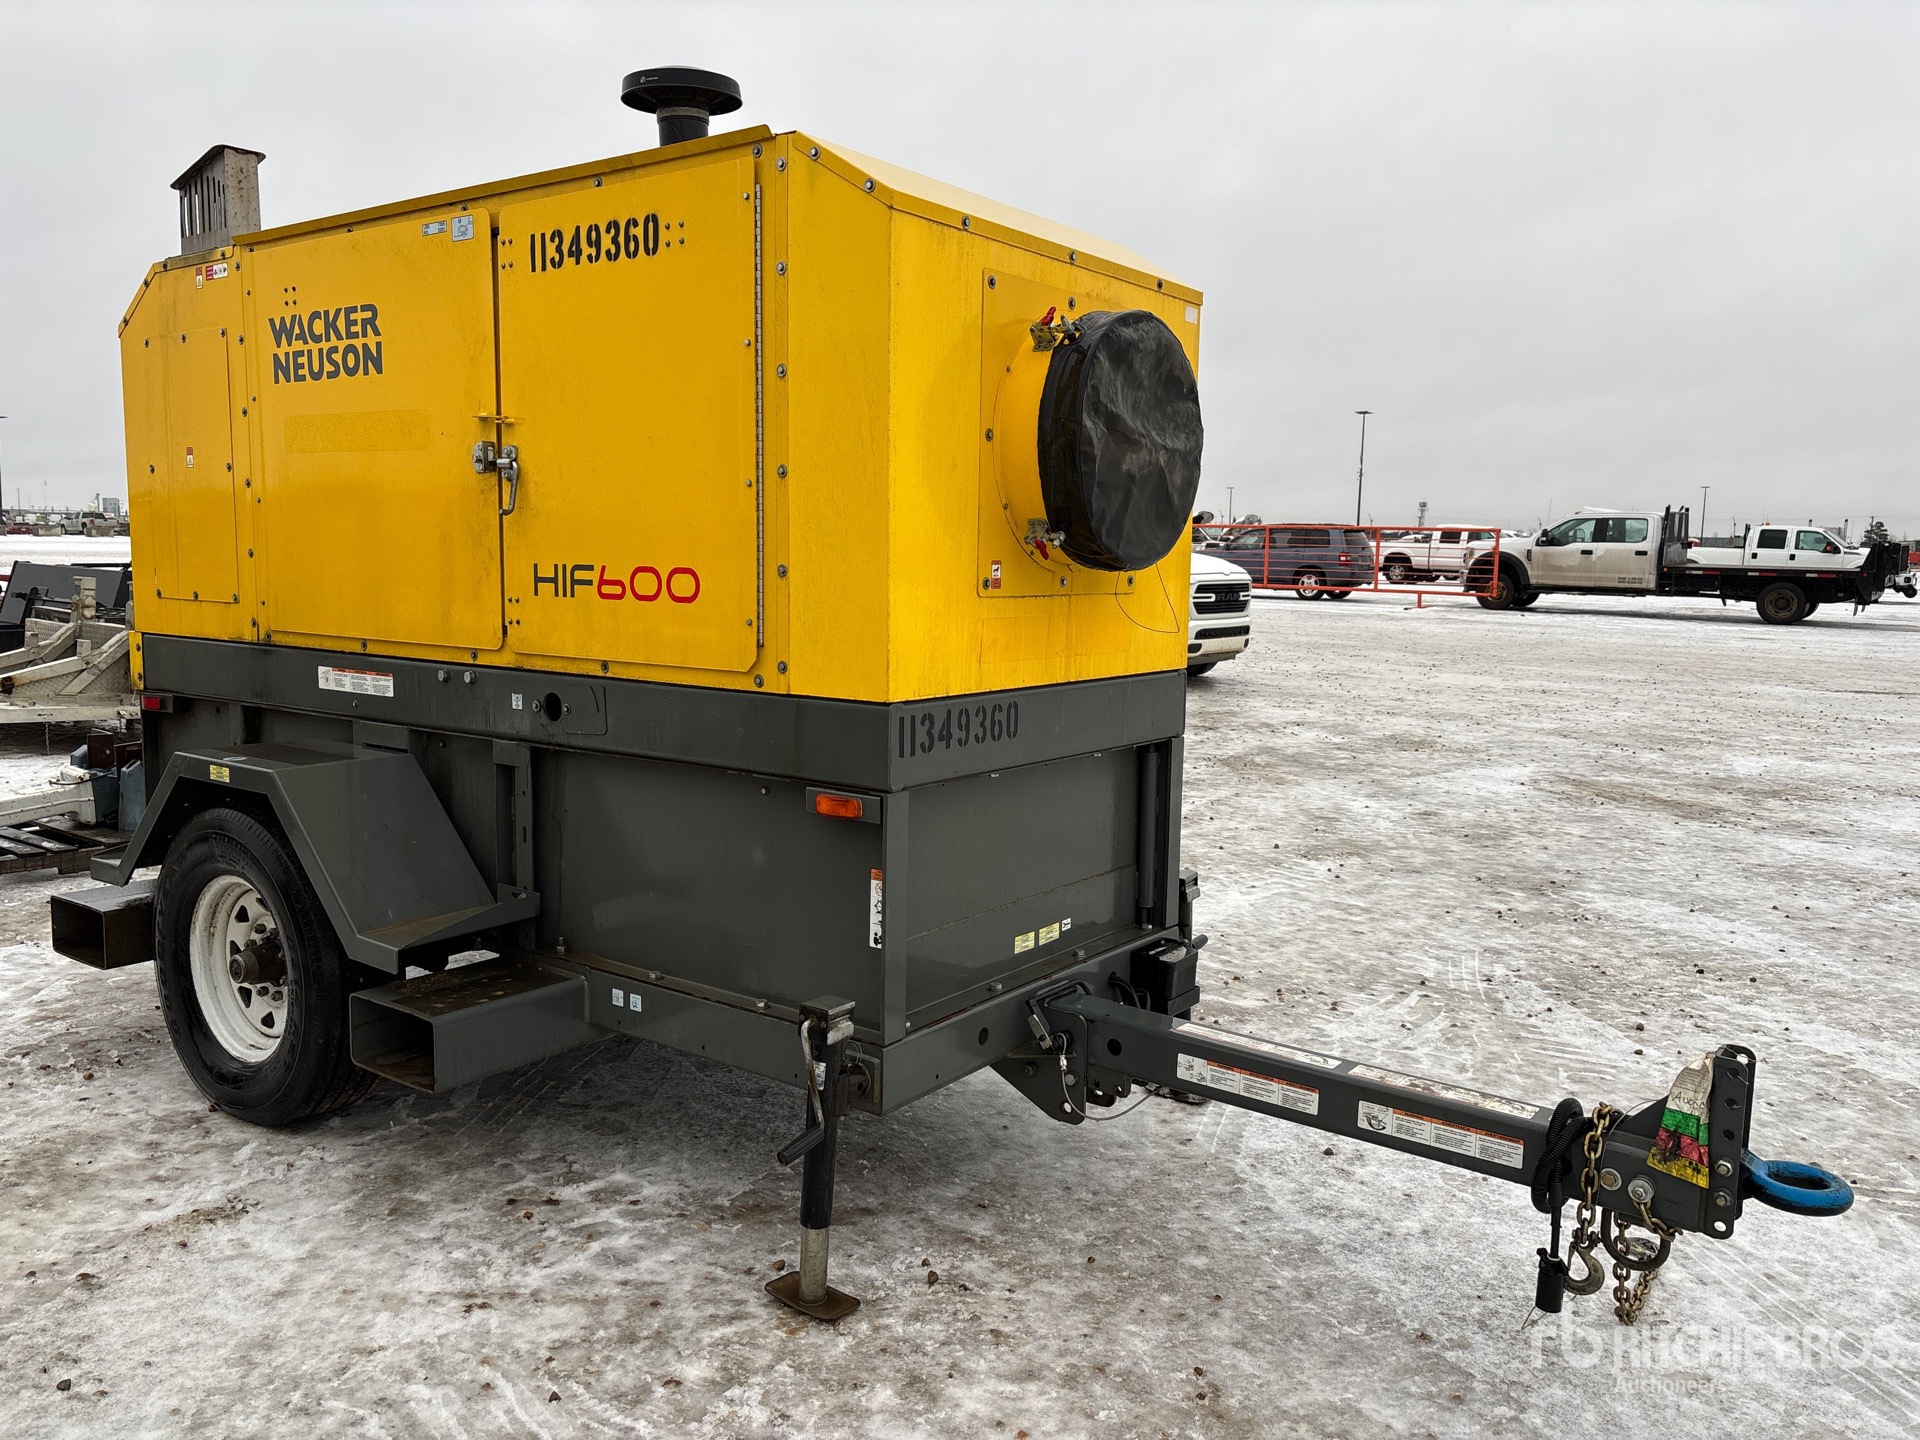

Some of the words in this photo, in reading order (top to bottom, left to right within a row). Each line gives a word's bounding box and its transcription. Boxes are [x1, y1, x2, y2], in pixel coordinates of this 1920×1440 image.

[530, 213, 660, 273] 11349360
[268, 303, 382, 349] WACKER
[273, 342, 383, 385] NEUSON
[533, 562, 701, 604] HIF600
[898, 701, 1020, 758] 11349360
